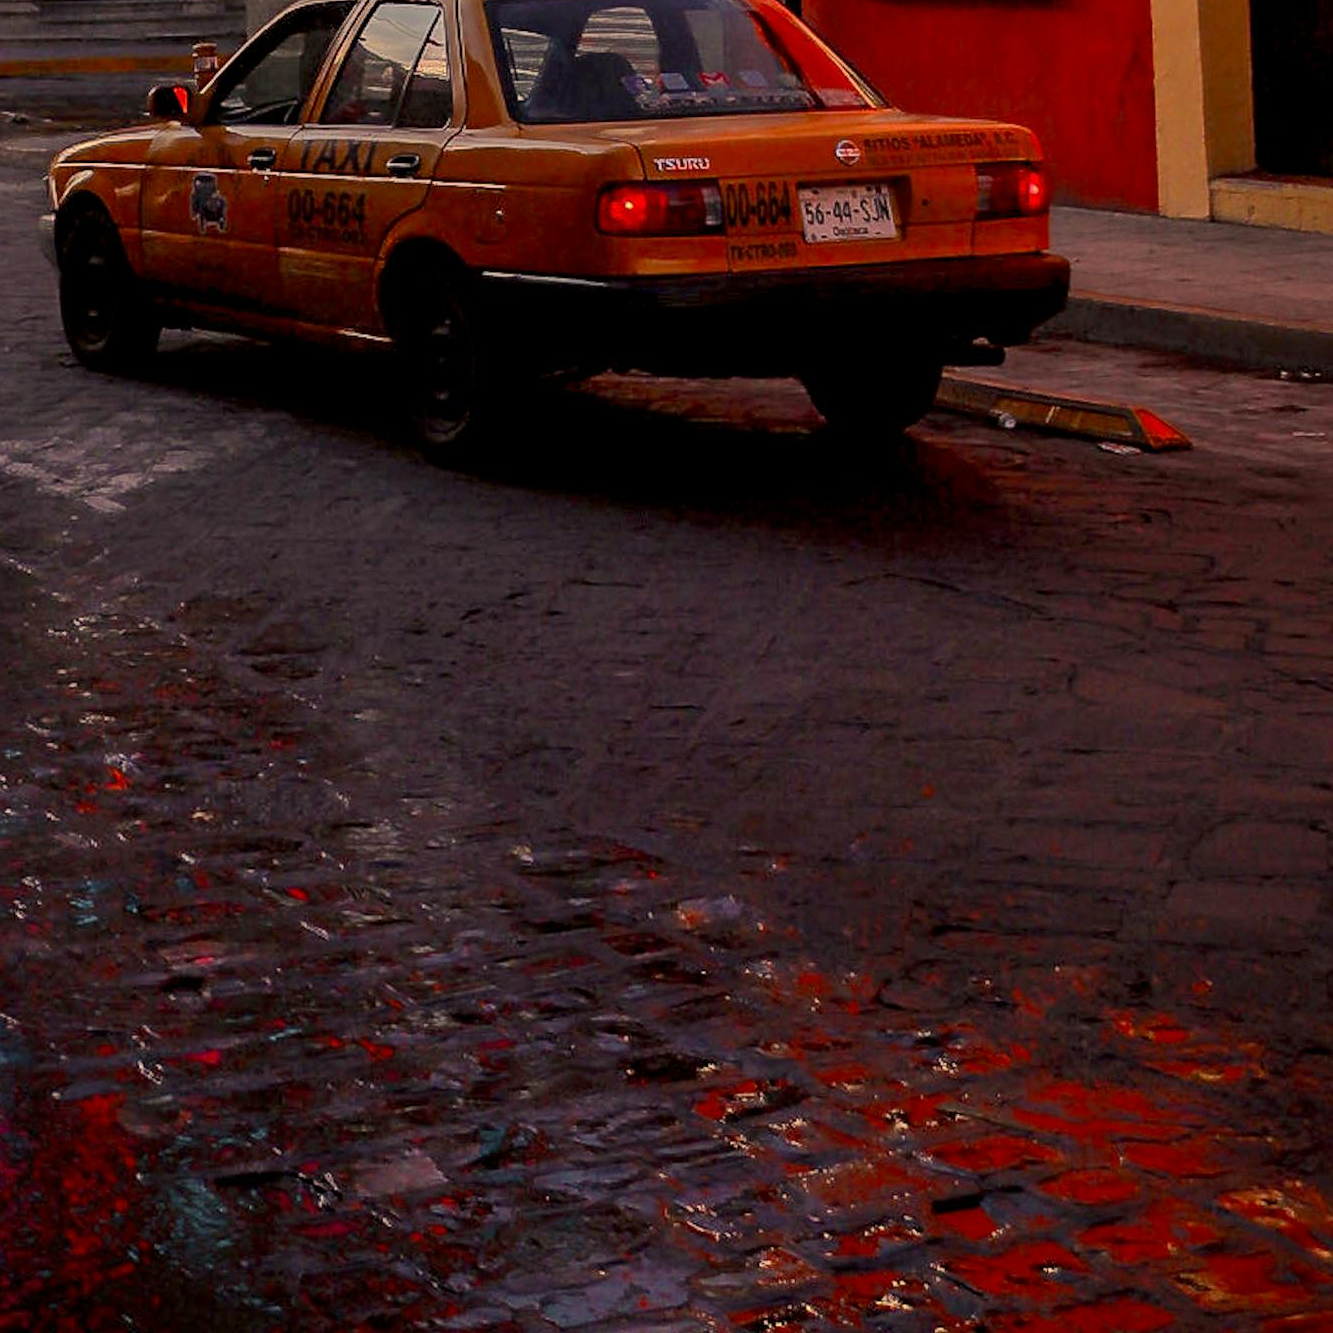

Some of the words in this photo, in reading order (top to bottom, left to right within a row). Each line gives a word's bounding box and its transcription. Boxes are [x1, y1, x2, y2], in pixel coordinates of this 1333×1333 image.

[299, 139, 378, 173] TAXI
[653, 157, 710, 172] TSURU
[287, 188, 366, 227] 00-664
[726, 180, 791, 227] 00-664
[805, 196, 892, 226] 56-44-SJN
